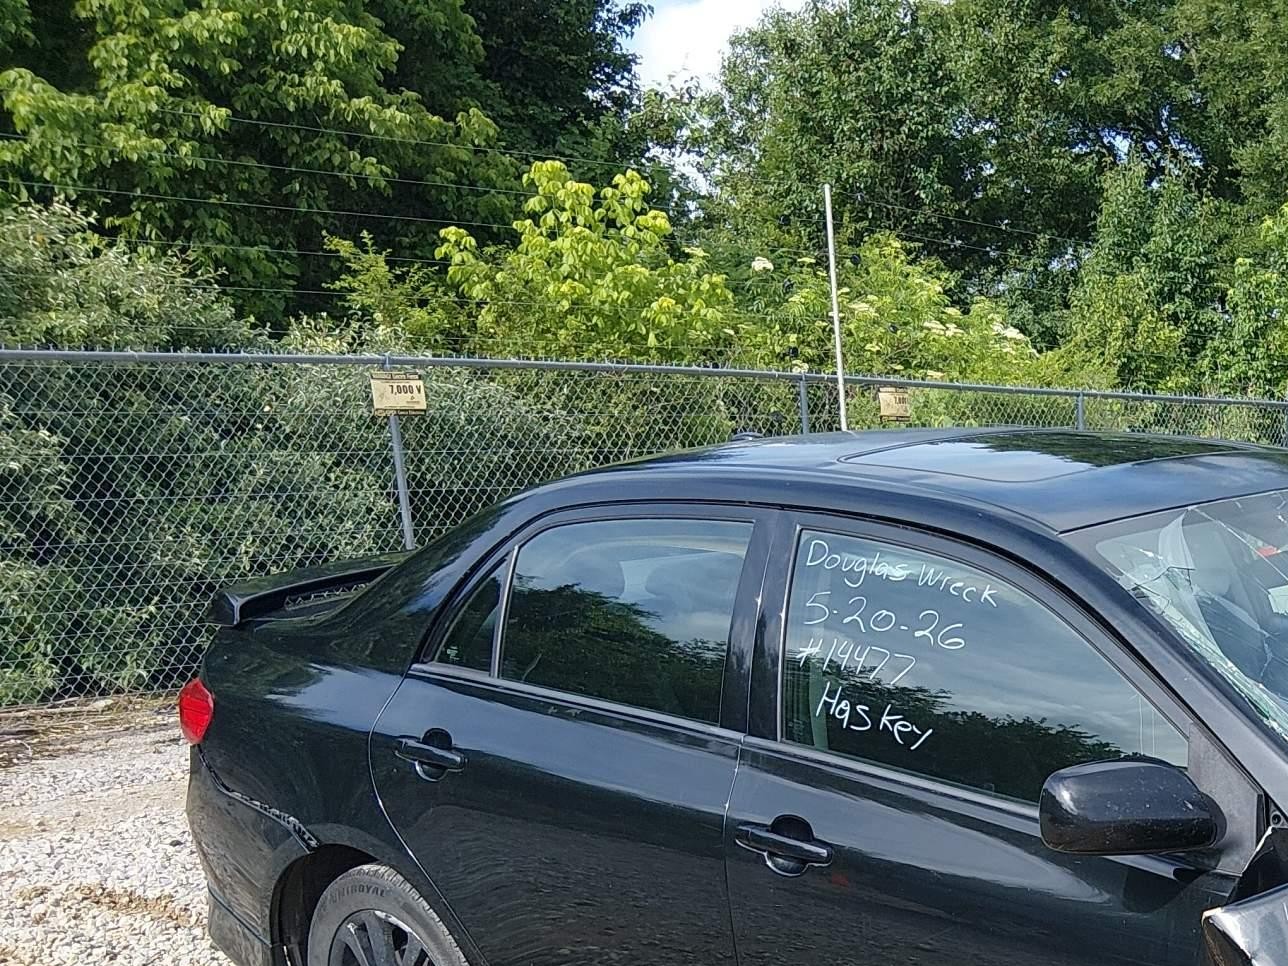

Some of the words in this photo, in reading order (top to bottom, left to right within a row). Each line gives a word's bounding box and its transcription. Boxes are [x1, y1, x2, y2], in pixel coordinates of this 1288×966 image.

[389, 384, 414, 396] 7,000
[415, 384, 422, 395] V
[806, 539, 911, 588] Douglas
[917, 563, 998, 608] Wreck
[797, 638, 916, 685] #14477
[815, 682, 872, 731] Has
